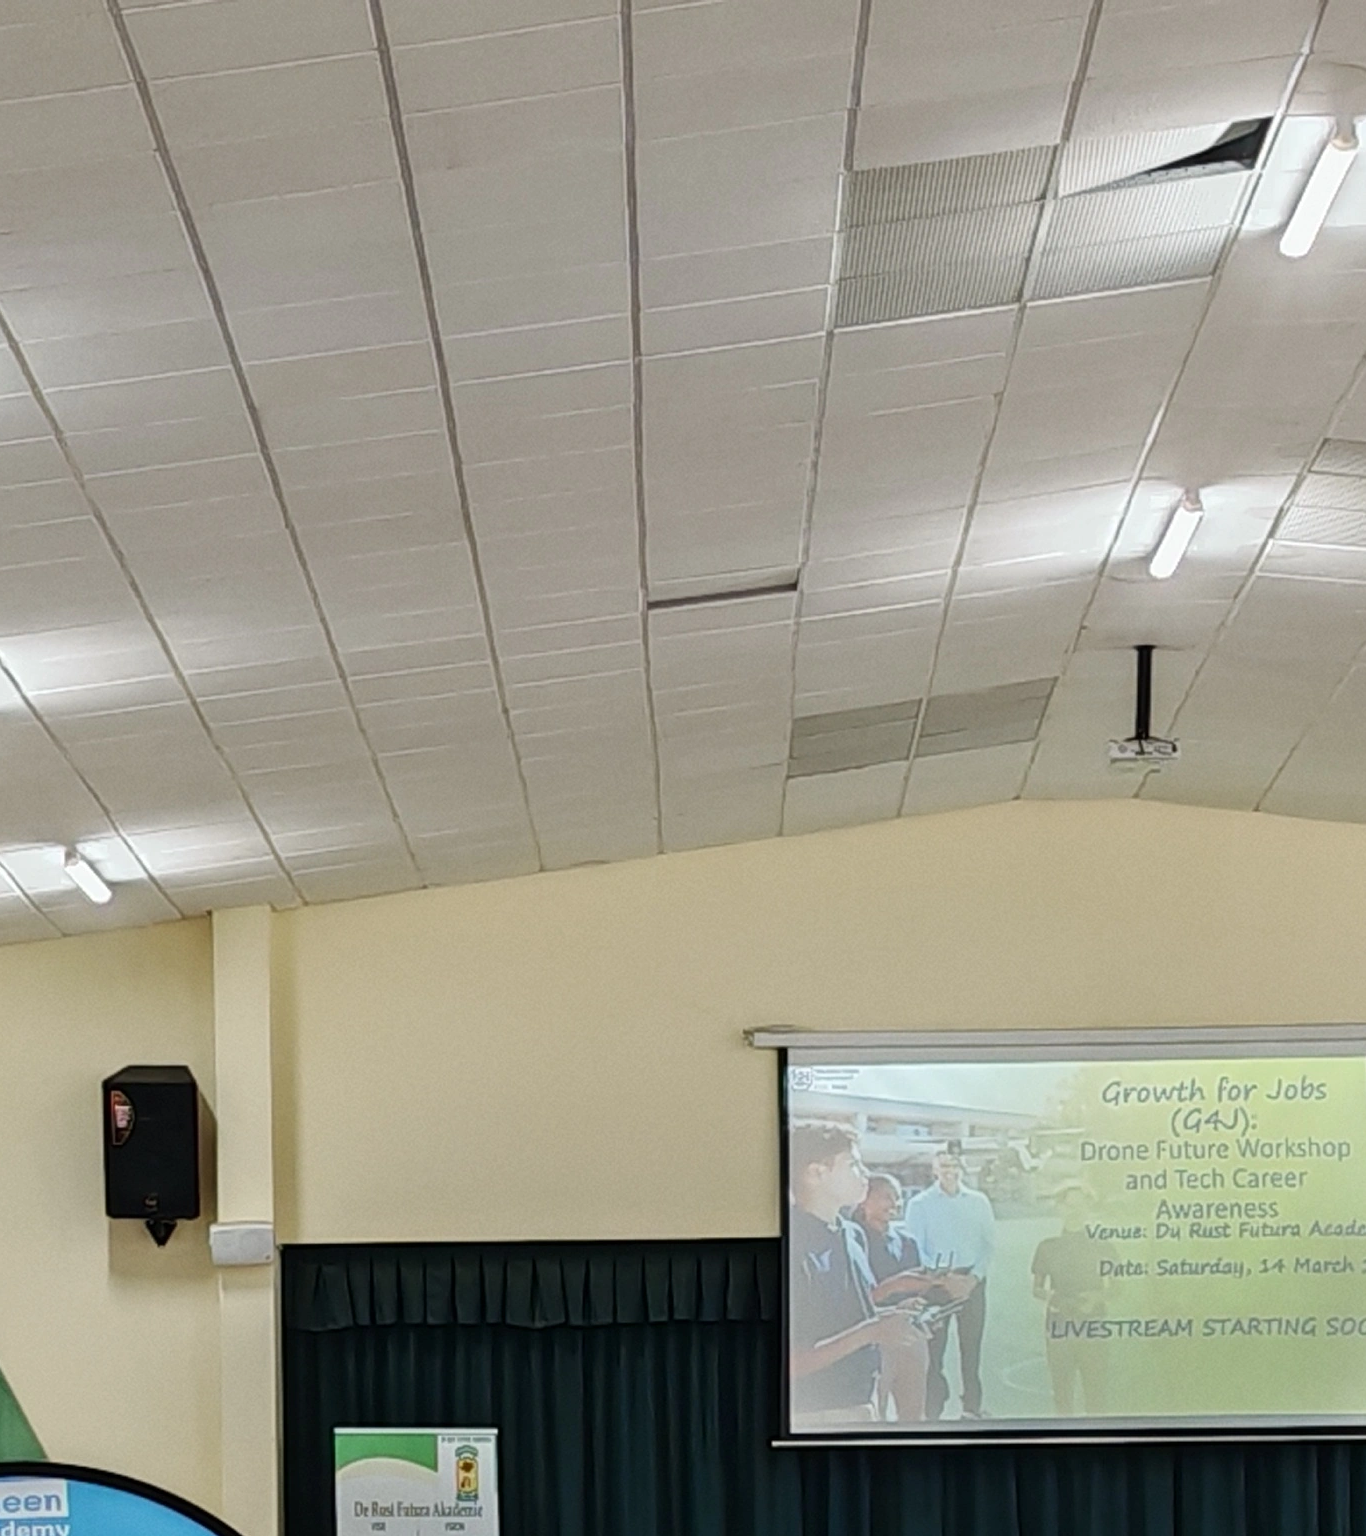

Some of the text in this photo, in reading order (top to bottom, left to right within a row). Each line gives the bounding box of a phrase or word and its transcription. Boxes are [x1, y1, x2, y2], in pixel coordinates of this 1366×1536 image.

[1101, 1075, 1328, 1106] Growth for Jobs
[1170, 1107, 1258, 1138] (G4J):
[1080, 1137, 1352, 1162] Drone Future Workshop
[1125, 1168, 1308, 1190] and Tech Career
[1155, 1200, 1280, 1220] Awareness
[1086, 1223, 1148, 1240] Venue:
[1189, 1222, 1232, 1239] Rust
[1238, 1221, 1301, 1239] Futura
[1099, 1260, 1149, 1277] Date:
[1156, 1257, 1252, 1278] Saturday,
[1258, 1258, 1286, 1274] 14
[1293, 1254, 1355, 1274] March
[1051, 1318, 1193, 1339] LIVESTREAM
[1202, 1317, 1317, 1338] STARTING
[353, 1501, 369, 1518] De
